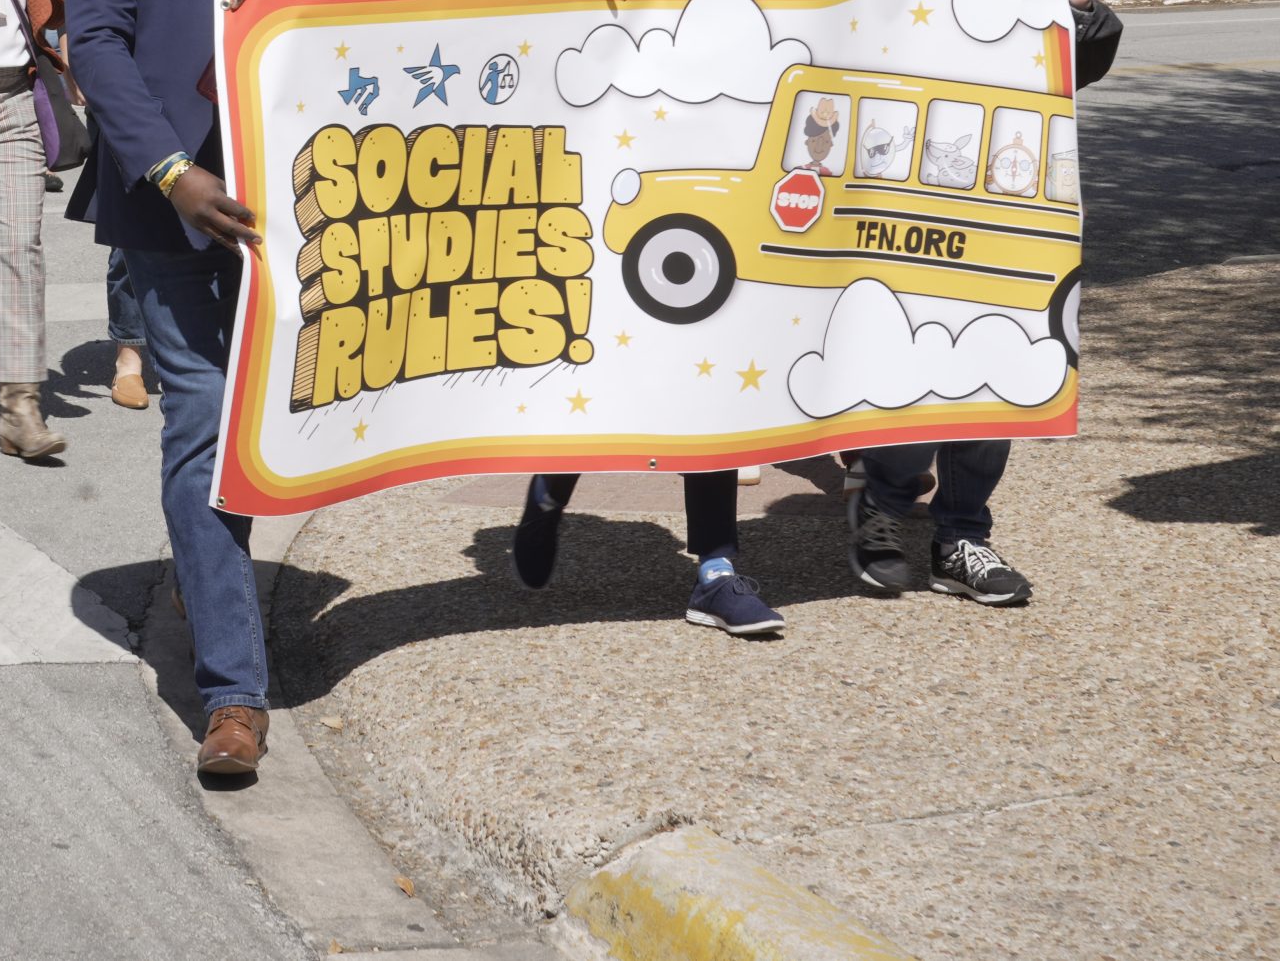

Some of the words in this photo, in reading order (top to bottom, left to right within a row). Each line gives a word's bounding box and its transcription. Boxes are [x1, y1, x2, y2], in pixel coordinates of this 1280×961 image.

[308, 124, 584, 219] SOCIAL
[776, 191, 820, 210] STOP
[319, 206, 595, 305] STUDIES
[855, 220, 967, 259] TFN.ORG
[310, 277, 595, 406] RULES!
